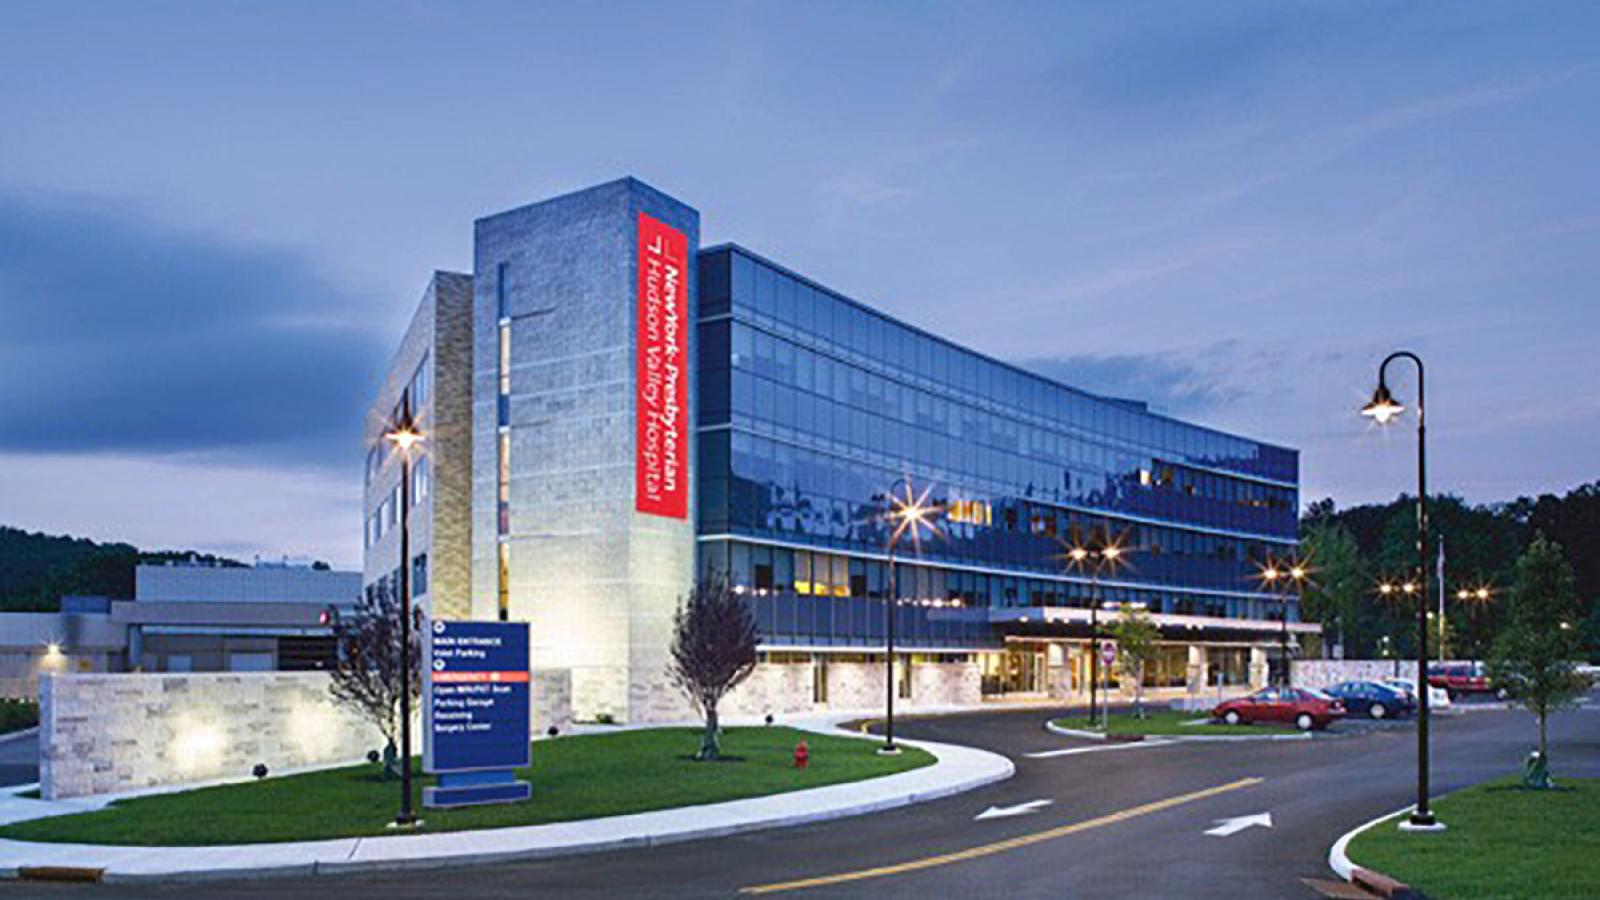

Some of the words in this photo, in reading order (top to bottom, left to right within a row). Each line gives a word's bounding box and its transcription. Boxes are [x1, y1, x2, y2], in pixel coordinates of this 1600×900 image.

[646, 257, 661, 341] Hudson
[642, 346, 661, 408] Valley
[661, 264, 679, 491] NewYork-Presbyterian
[642, 410, 661, 501] Hospital
[455, 648, 486, 659] Parking
[434, 698, 464, 708] Parking
[466, 697, 494, 707] Garage
[466, 722, 491, 731] Center
